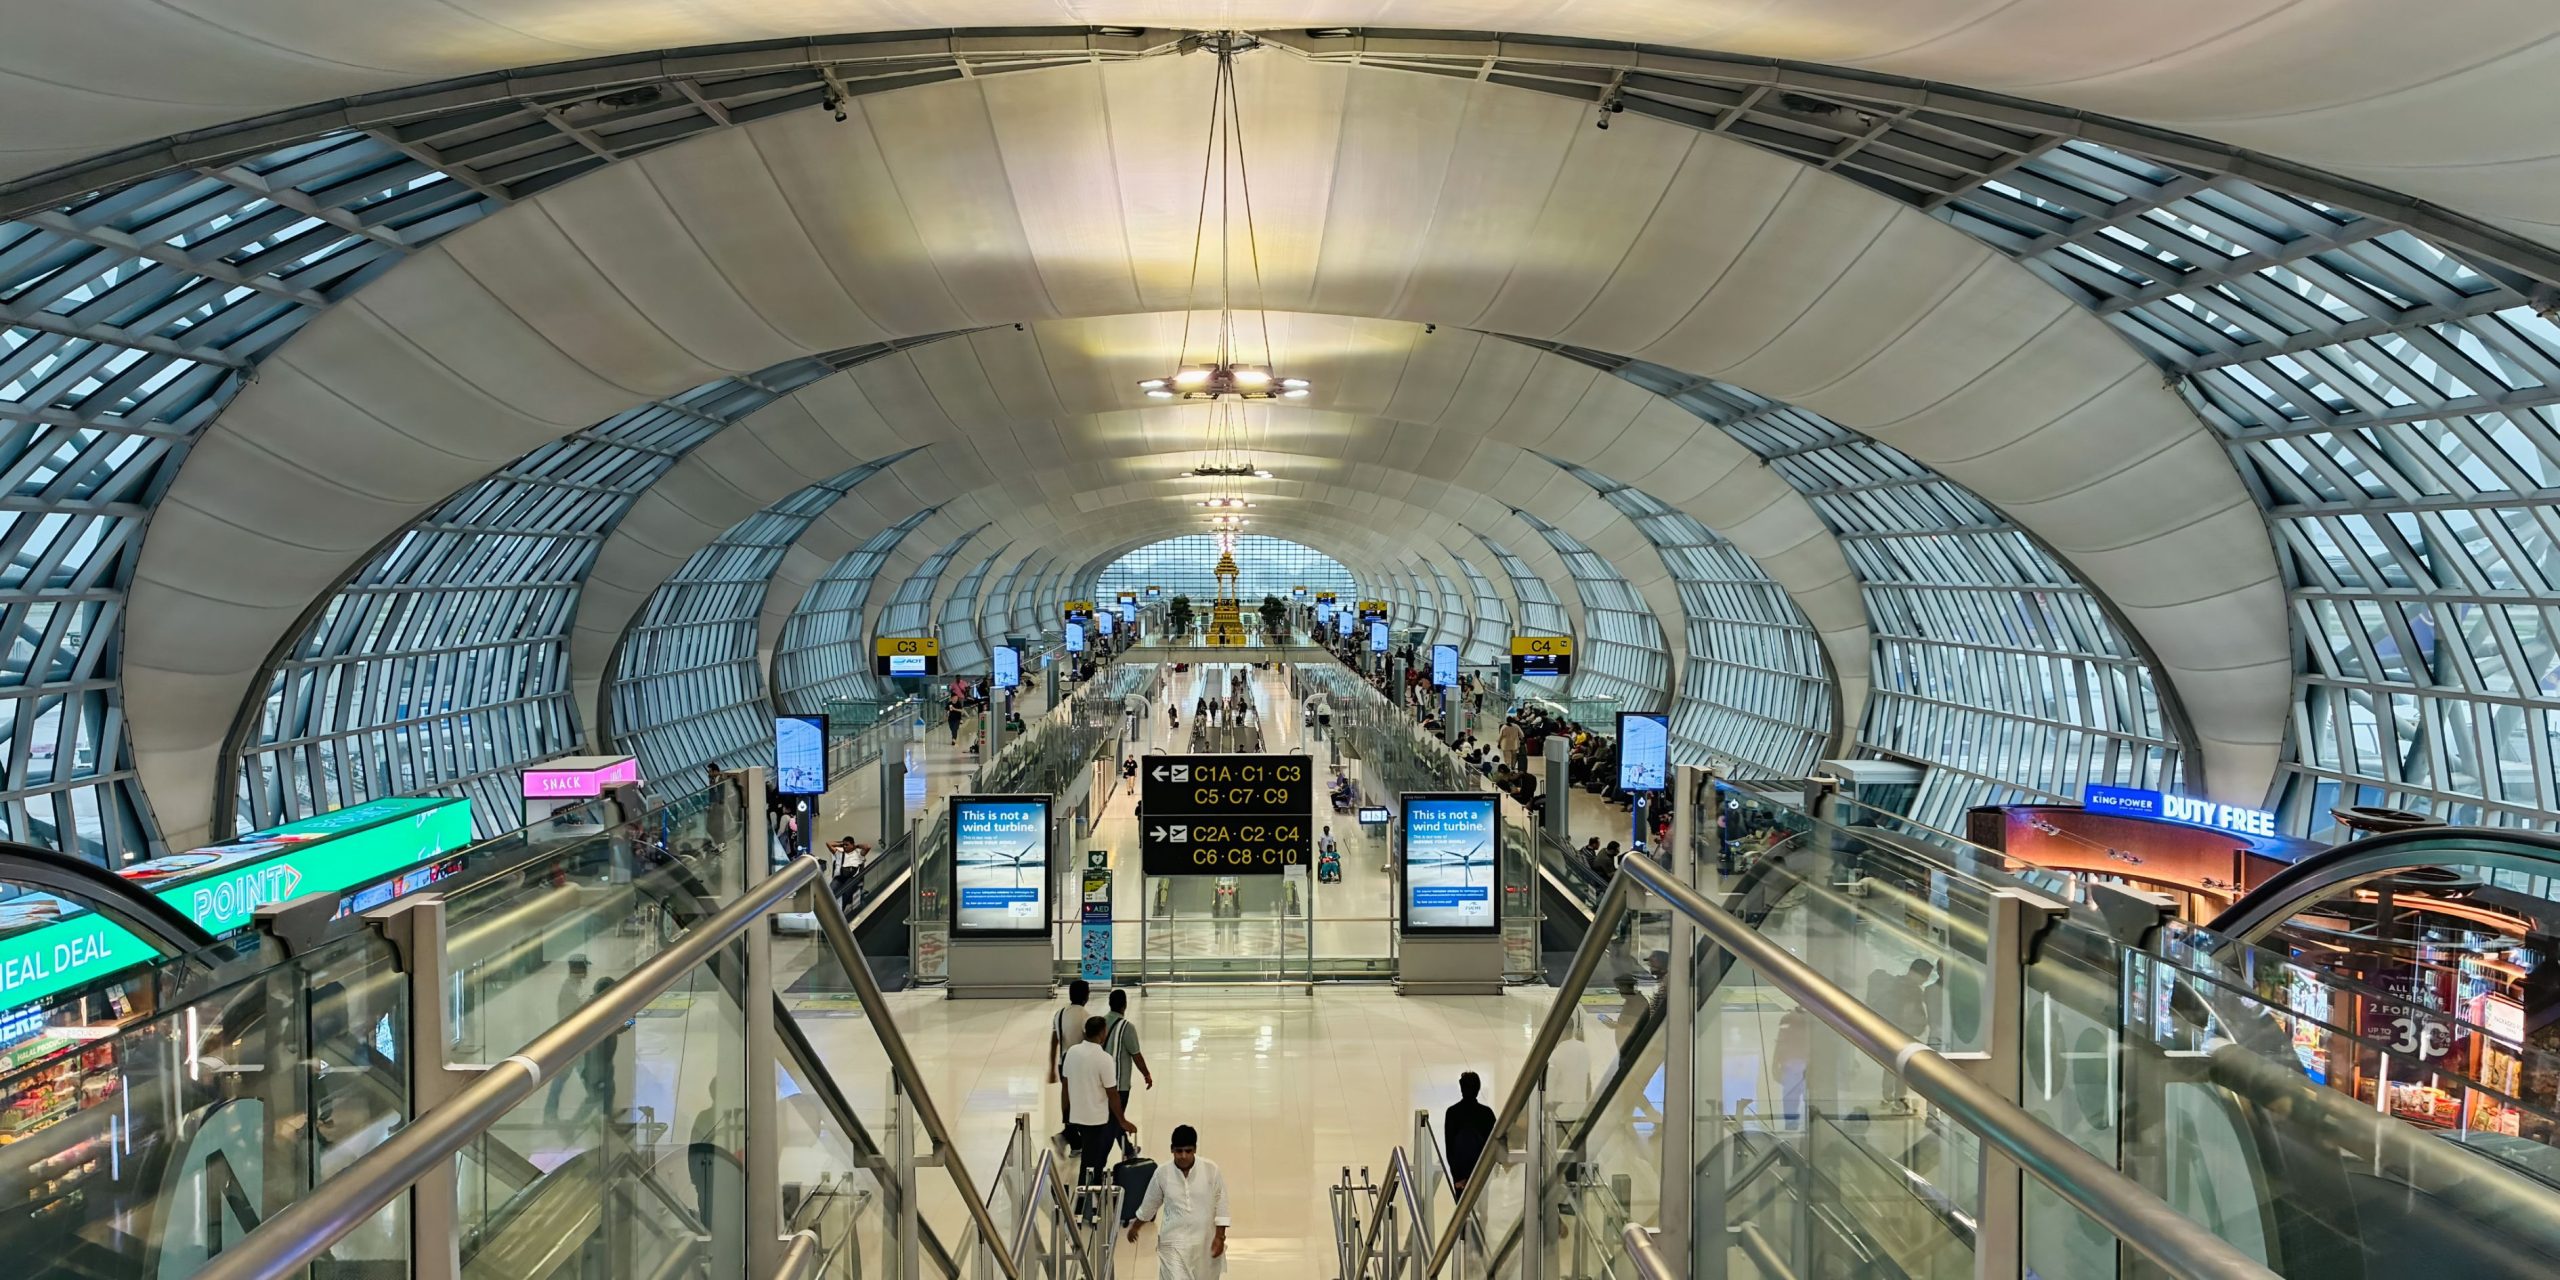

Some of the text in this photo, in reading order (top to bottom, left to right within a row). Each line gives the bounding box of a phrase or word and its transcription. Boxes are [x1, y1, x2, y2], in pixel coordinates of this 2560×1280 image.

[897, 640, 917, 653] C3
[1531, 640, 1551, 652] C4
[1194, 765, 1301, 782] C1A C1 C3
[542, 776, 581, 791] SNACK
[1194, 788, 1288, 804] C5 C7 C9
[2092, 795, 2118, 805] KING
[2119, 798, 2153, 809] POWER
[962, 810, 1029, 820] This is not a
[1412, 810, 1478, 820] This is not a
[2163, 794, 2275, 837] DUTY FREE
[962, 822, 1037, 832] wind turbine.
[1413, 821, 1486, 831] wind turbine.
[1193, 826, 1300, 842] C2A C2 C4
[1193, 849, 1297, 865] C6 C8 C10
[194, 864, 284, 927] POINT
[0, 931, 111, 992] EAL DEAL
[2388, 984, 2408, 993] ALL
[2370, 1004, 2377, 1012] 2
[2382, 1005, 2410, 1016] FOR
